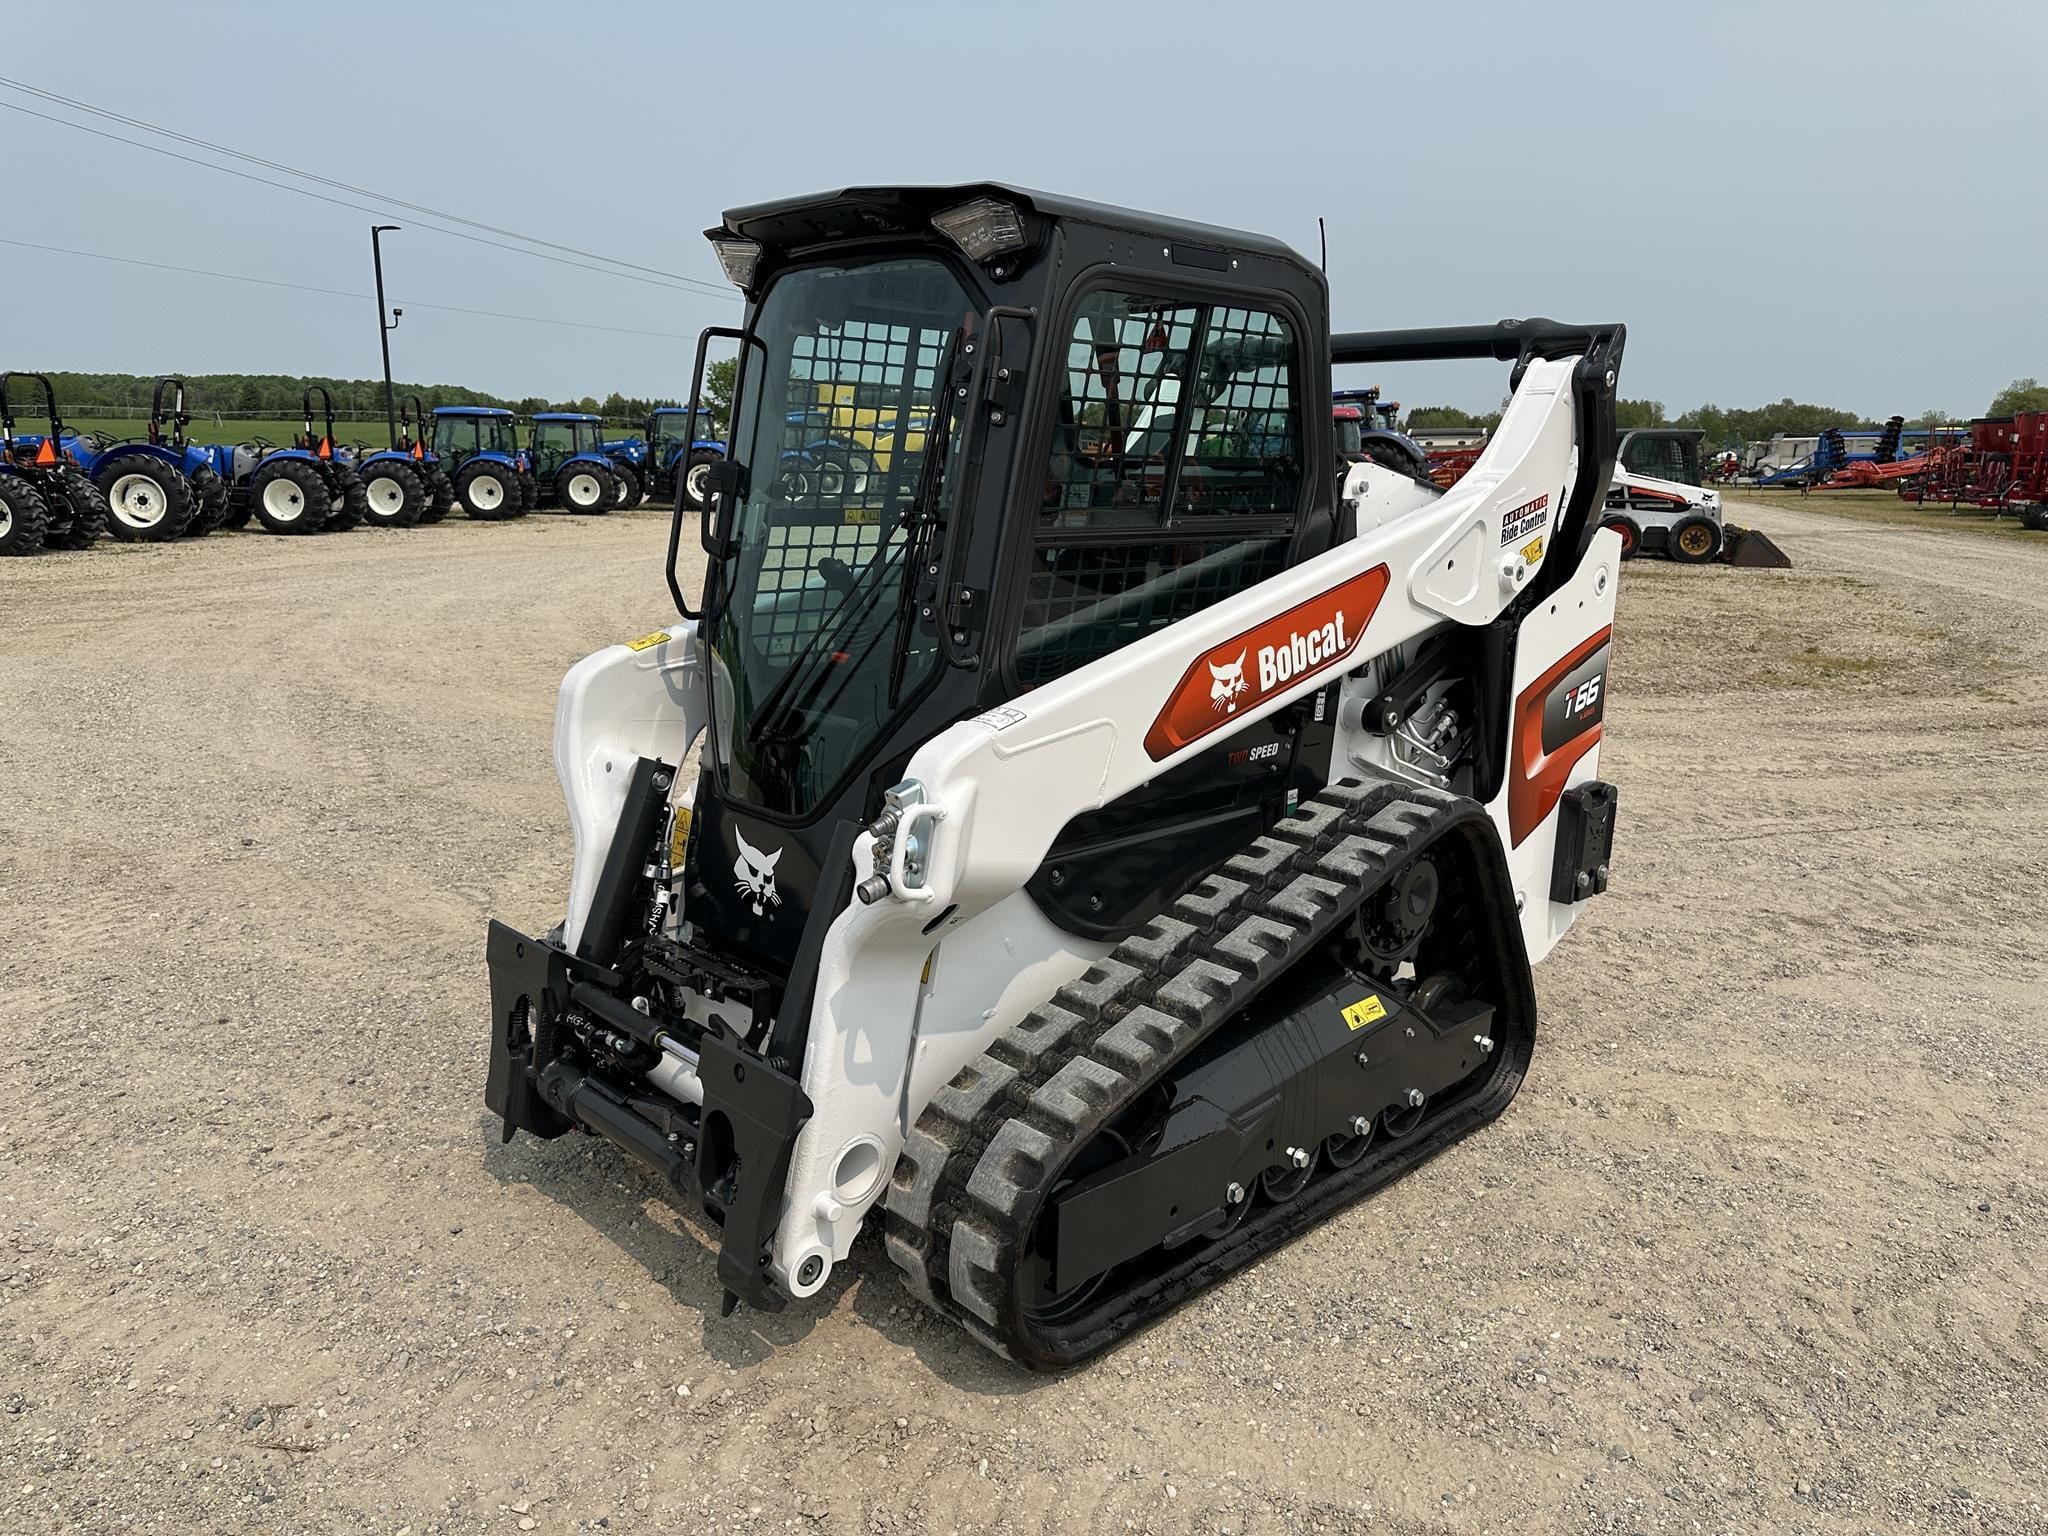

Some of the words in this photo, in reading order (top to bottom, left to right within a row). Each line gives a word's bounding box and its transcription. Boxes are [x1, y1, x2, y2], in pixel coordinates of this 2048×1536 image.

[1501, 524, 1519, 544] Ride
[1520, 507, 1548, 534] Control
[1503, 496, 1548, 527] AUTOMATIC
[1257, 610, 1346, 693] Bobcat
[1565, 674, 1602, 719] T66
[1227, 749, 1249, 766] TWO
[1249, 742, 1279, 761] SPEED
